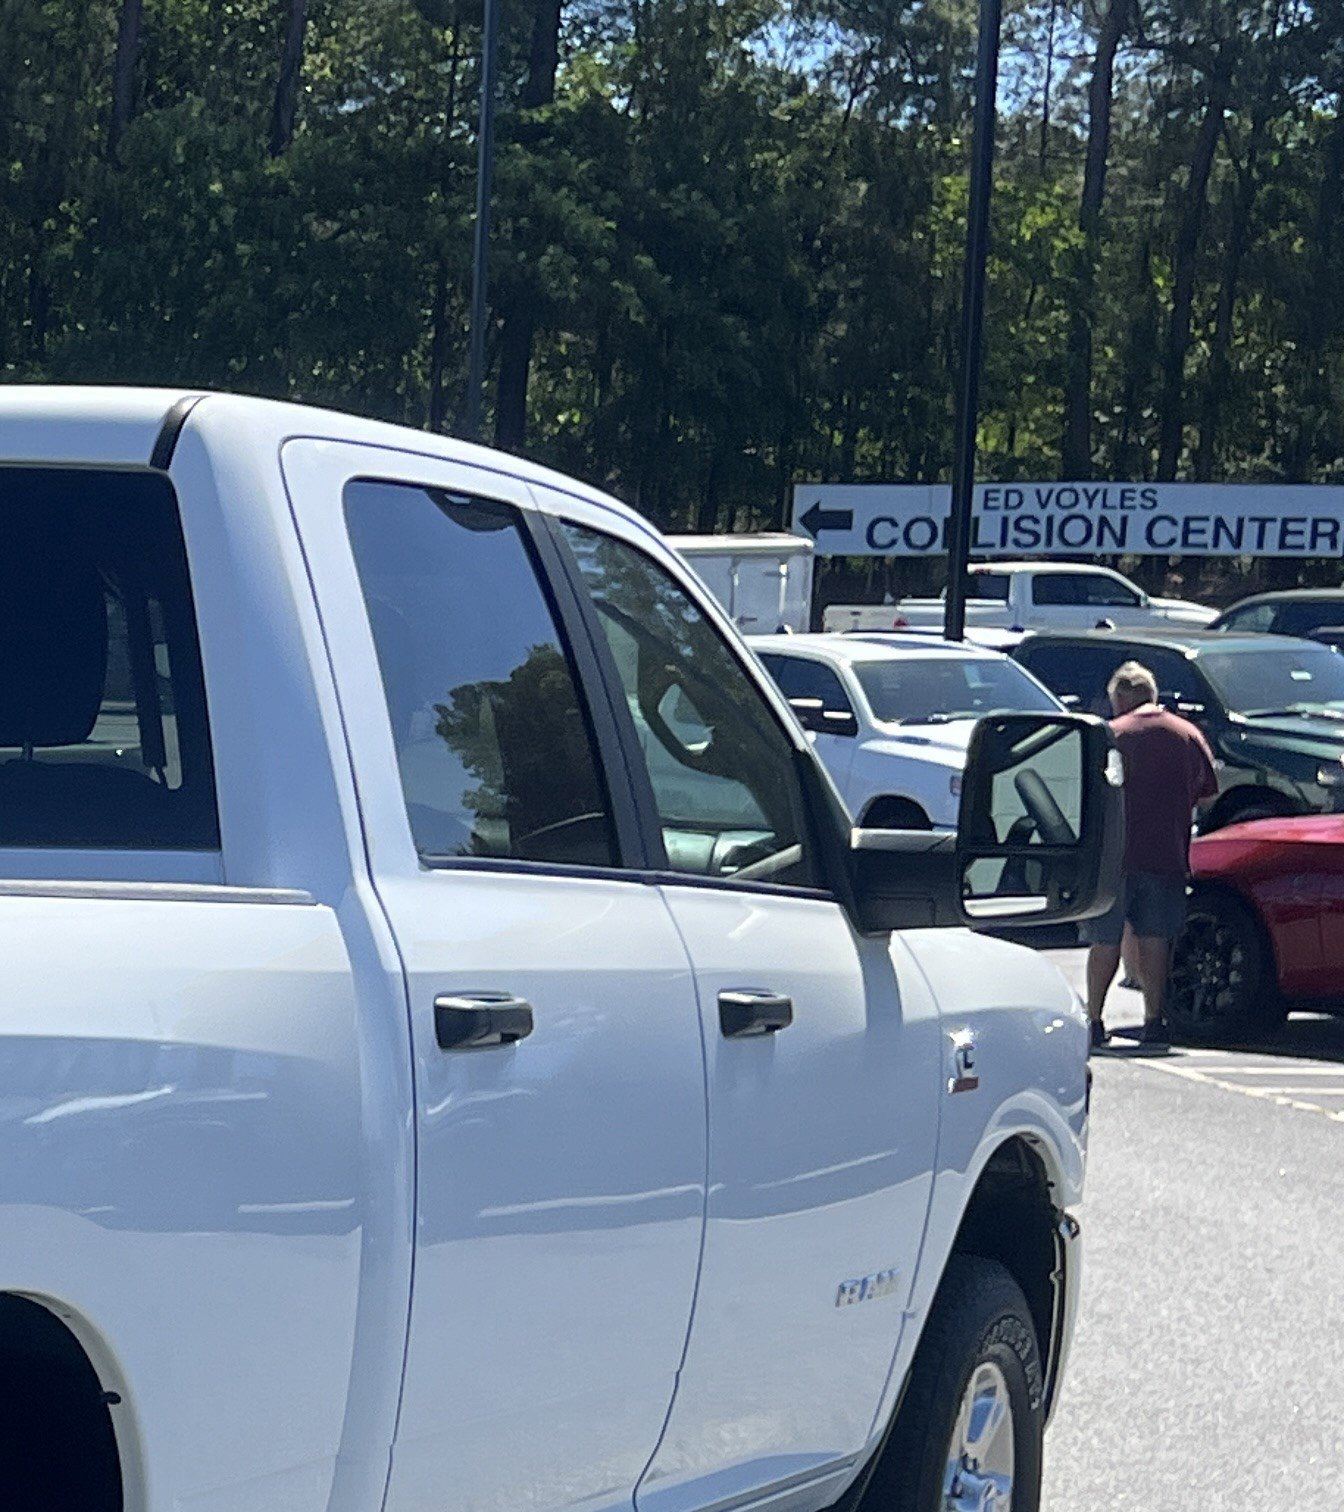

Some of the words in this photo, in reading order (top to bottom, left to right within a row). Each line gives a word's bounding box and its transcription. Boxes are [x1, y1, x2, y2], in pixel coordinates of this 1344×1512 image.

[983, 488, 1024, 511] ED
[1035, 487, 1158, 511] VOYLES
[1145, 514, 1341, 551] CENTER
